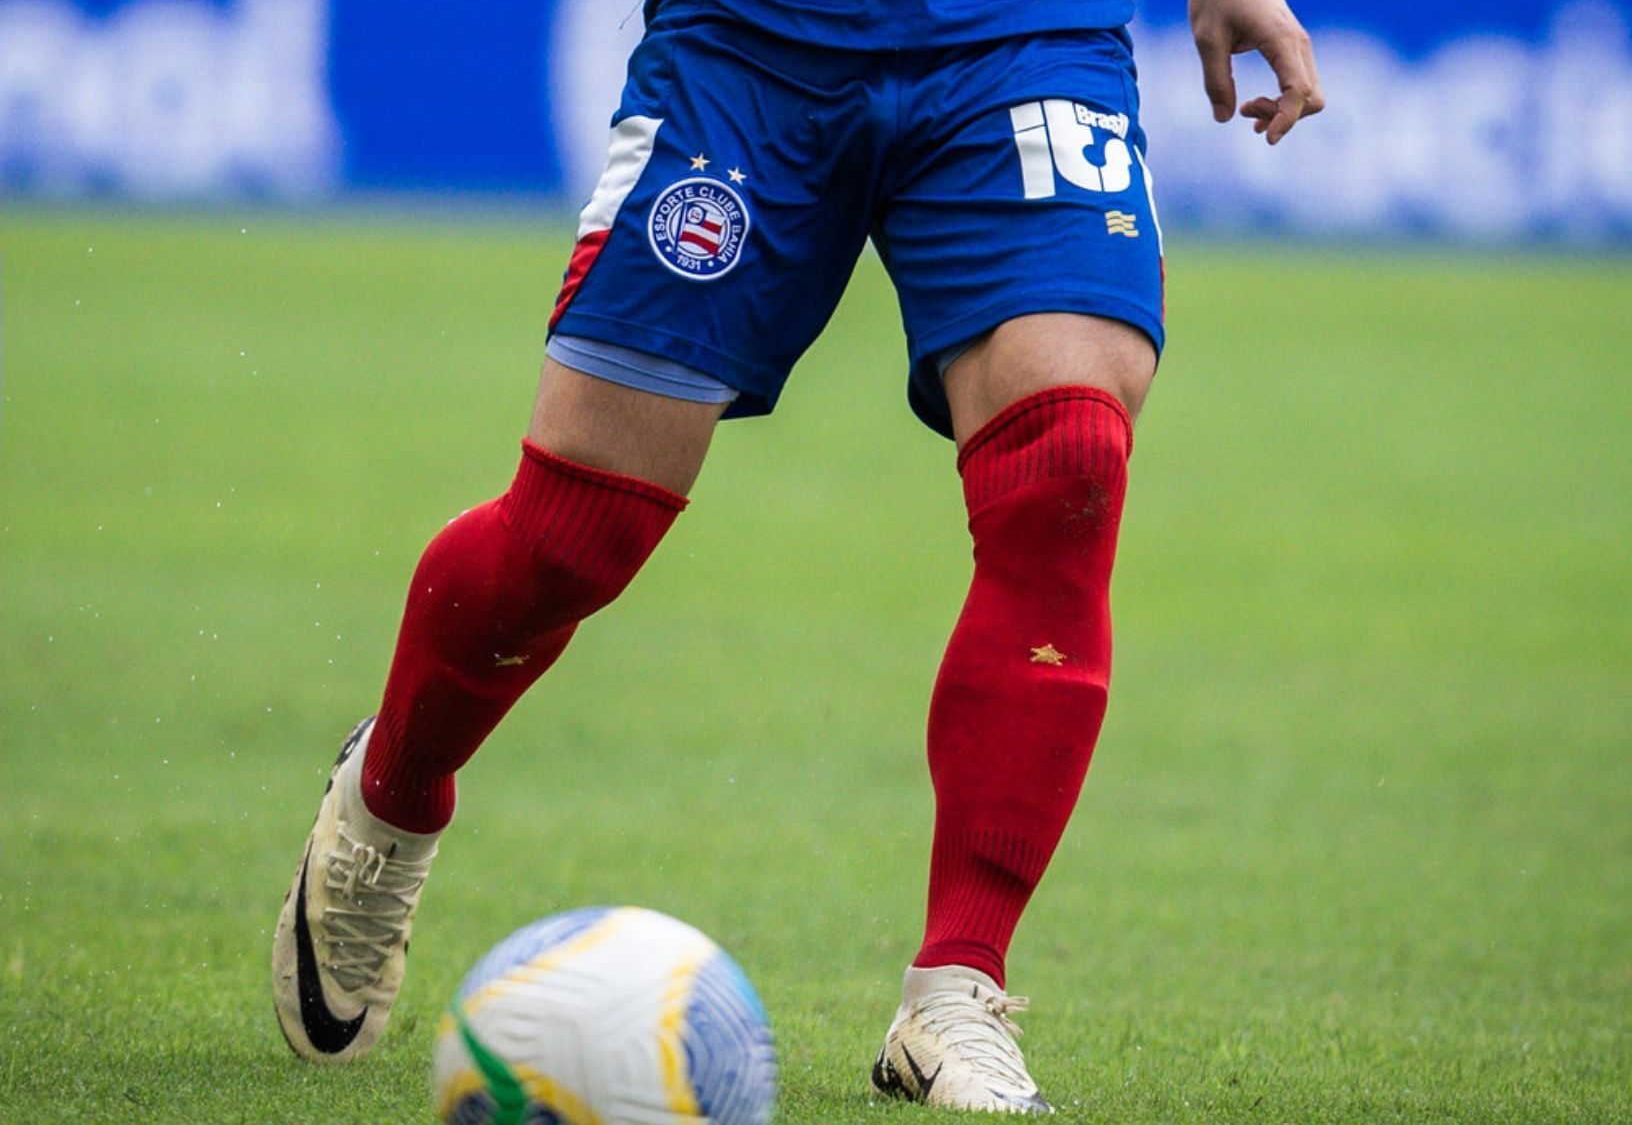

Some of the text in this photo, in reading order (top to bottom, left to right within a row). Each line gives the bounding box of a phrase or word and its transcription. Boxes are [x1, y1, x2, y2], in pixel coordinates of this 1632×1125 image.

[654, 186, 742, 263] ESPORTE CLUBE BAHIA
[677, 254, 701, 271] 1931
